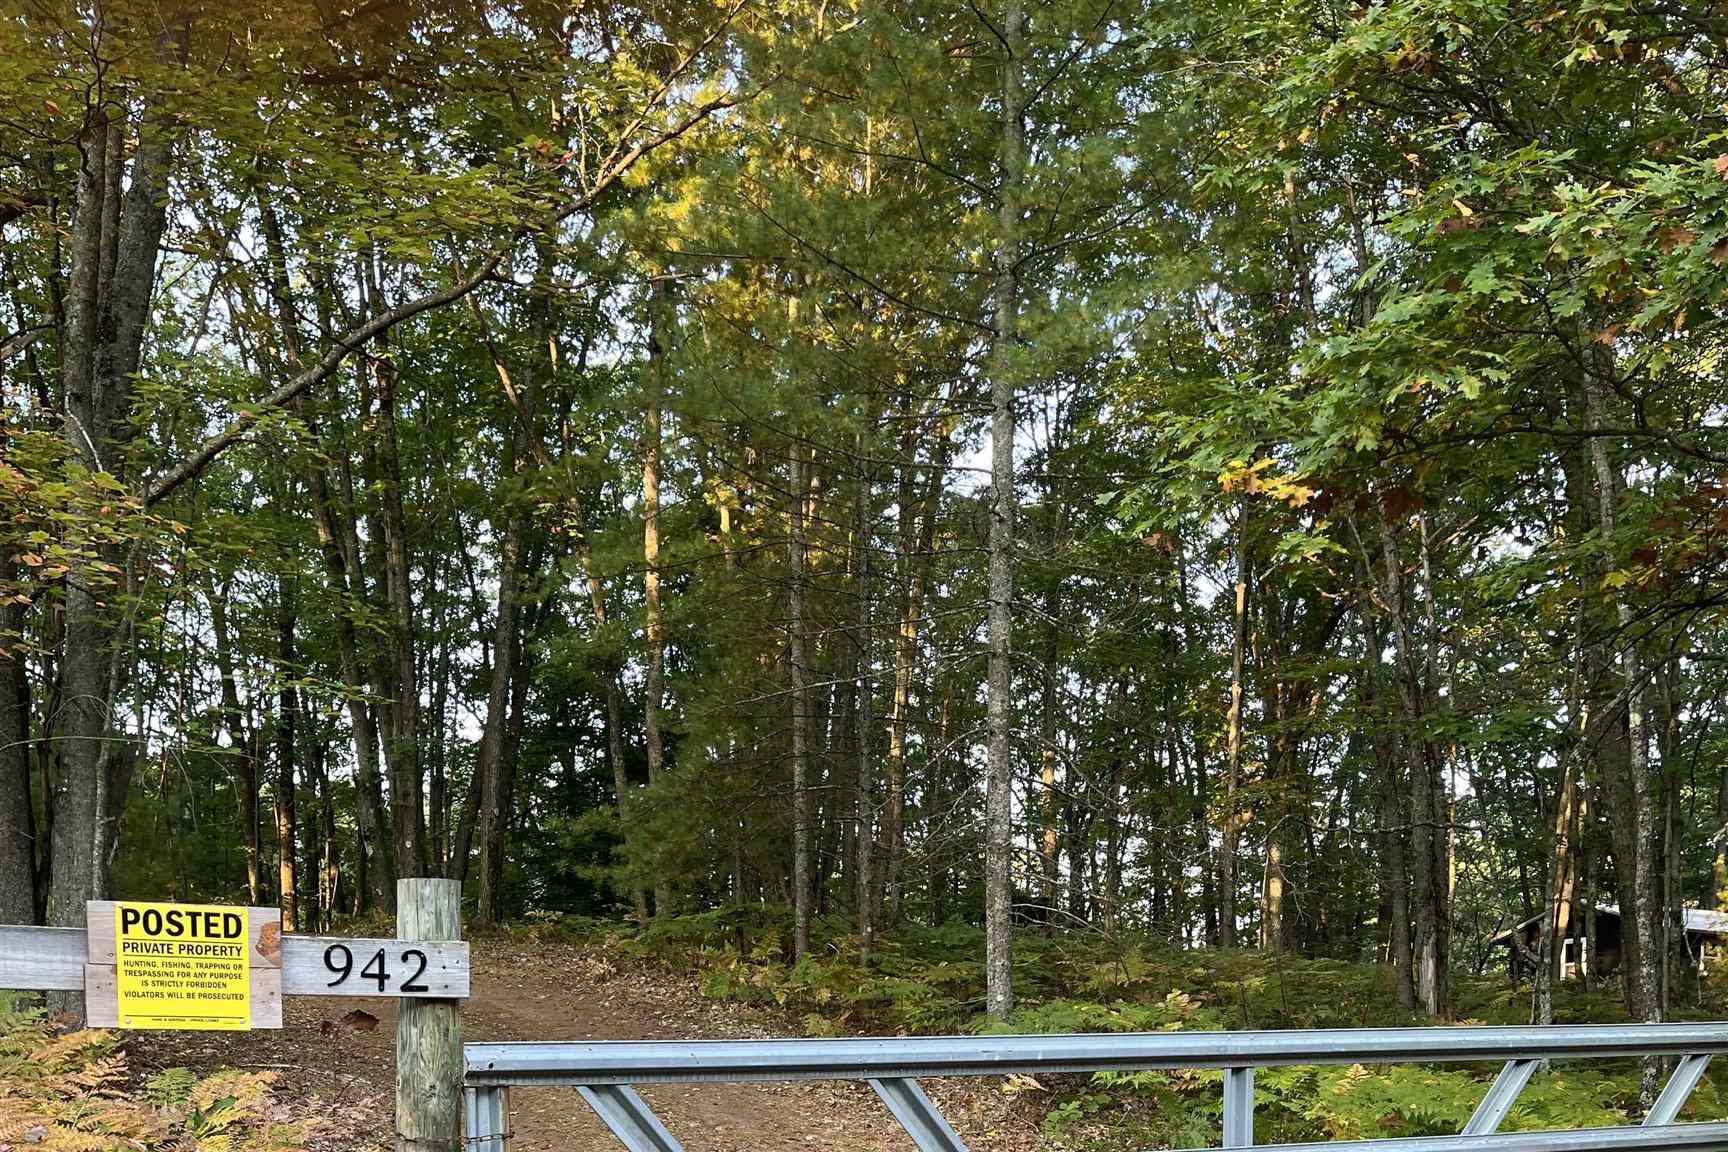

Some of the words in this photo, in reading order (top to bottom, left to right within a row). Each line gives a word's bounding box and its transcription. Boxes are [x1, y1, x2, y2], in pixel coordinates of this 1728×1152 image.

[121, 908, 243, 939] POSTED
[122, 942, 174, 955] PRIVATE
[178, 943, 243, 957] PROPERTY
[123, 960, 159, 969] HUNTING,
[161, 961, 193, 970] FISHING,
[195, 962, 231, 970] TRAPPING
[232, 963, 243, 971] OR
[323, 944, 429, 993] 942
[124, 969, 175, 978] TRESPASSING
[193, 971, 207, 979] ANY
[209, 972, 242, 980] PURPOSE
[141, 979, 149, 987] IS
[151, 980, 184, 988] STRICTLY
[186, 981, 227, 989] FORBIDDEN
[124, 990, 165, 999] VIOLATORS
[186, 992, 196, 1000] BE
[199, 993, 245, 1001] PROSECUTED
